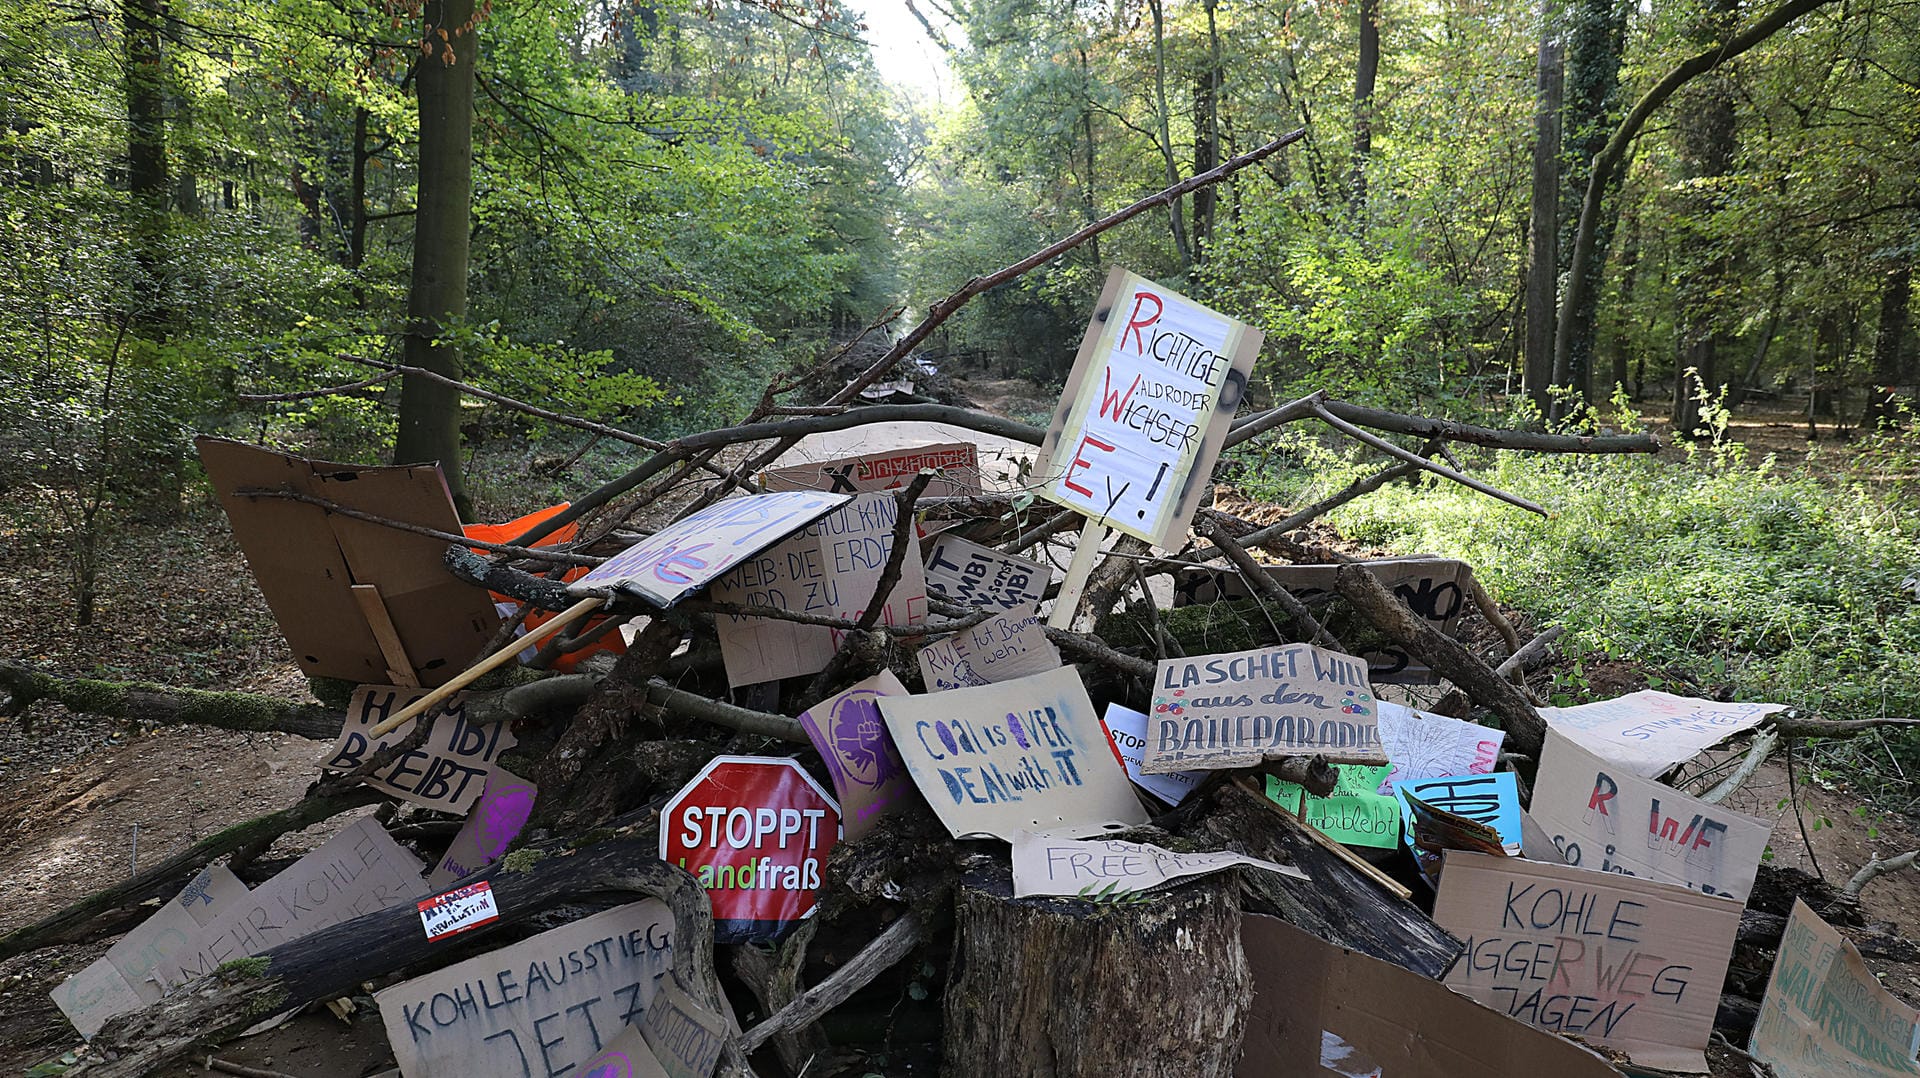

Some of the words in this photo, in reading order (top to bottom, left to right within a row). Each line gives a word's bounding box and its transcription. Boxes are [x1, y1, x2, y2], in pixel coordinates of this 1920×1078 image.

[1120, 292, 1228, 387] RICHTIGE
[787, 551, 823, 582] DIE
[803, 581, 839, 612] ZU
[922, 637, 971, 674] RWE
[971, 628, 996, 650] tut
[1163, 650, 1305, 690] LASCHET
[1310, 650, 1370, 689] WILL
[1190, 693, 1254, 709] aus
[1260, 682, 1334, 711] dem
[1006, 706, 1073, 751] OVER
[936, 761, 1020, 805] DEAL
[1052, 748, 1086, 787] IT
[681, 806, 826, 850] STOPPT
[286, 834, 383, 915] KOHLE
[680, 857, 821, 890] andfraß
[1046, 847, 1148, 881] FREE
[1503, 881, 1648, 944] KOHLE
[402, 922, 674, 1043] KOHLEAUSSTIEG
[1458, 934, 1586, 988] AGGER
[1596, 945, 1694, 1004] WEG
[1491, 987, 1636, 1039] JAGEN
